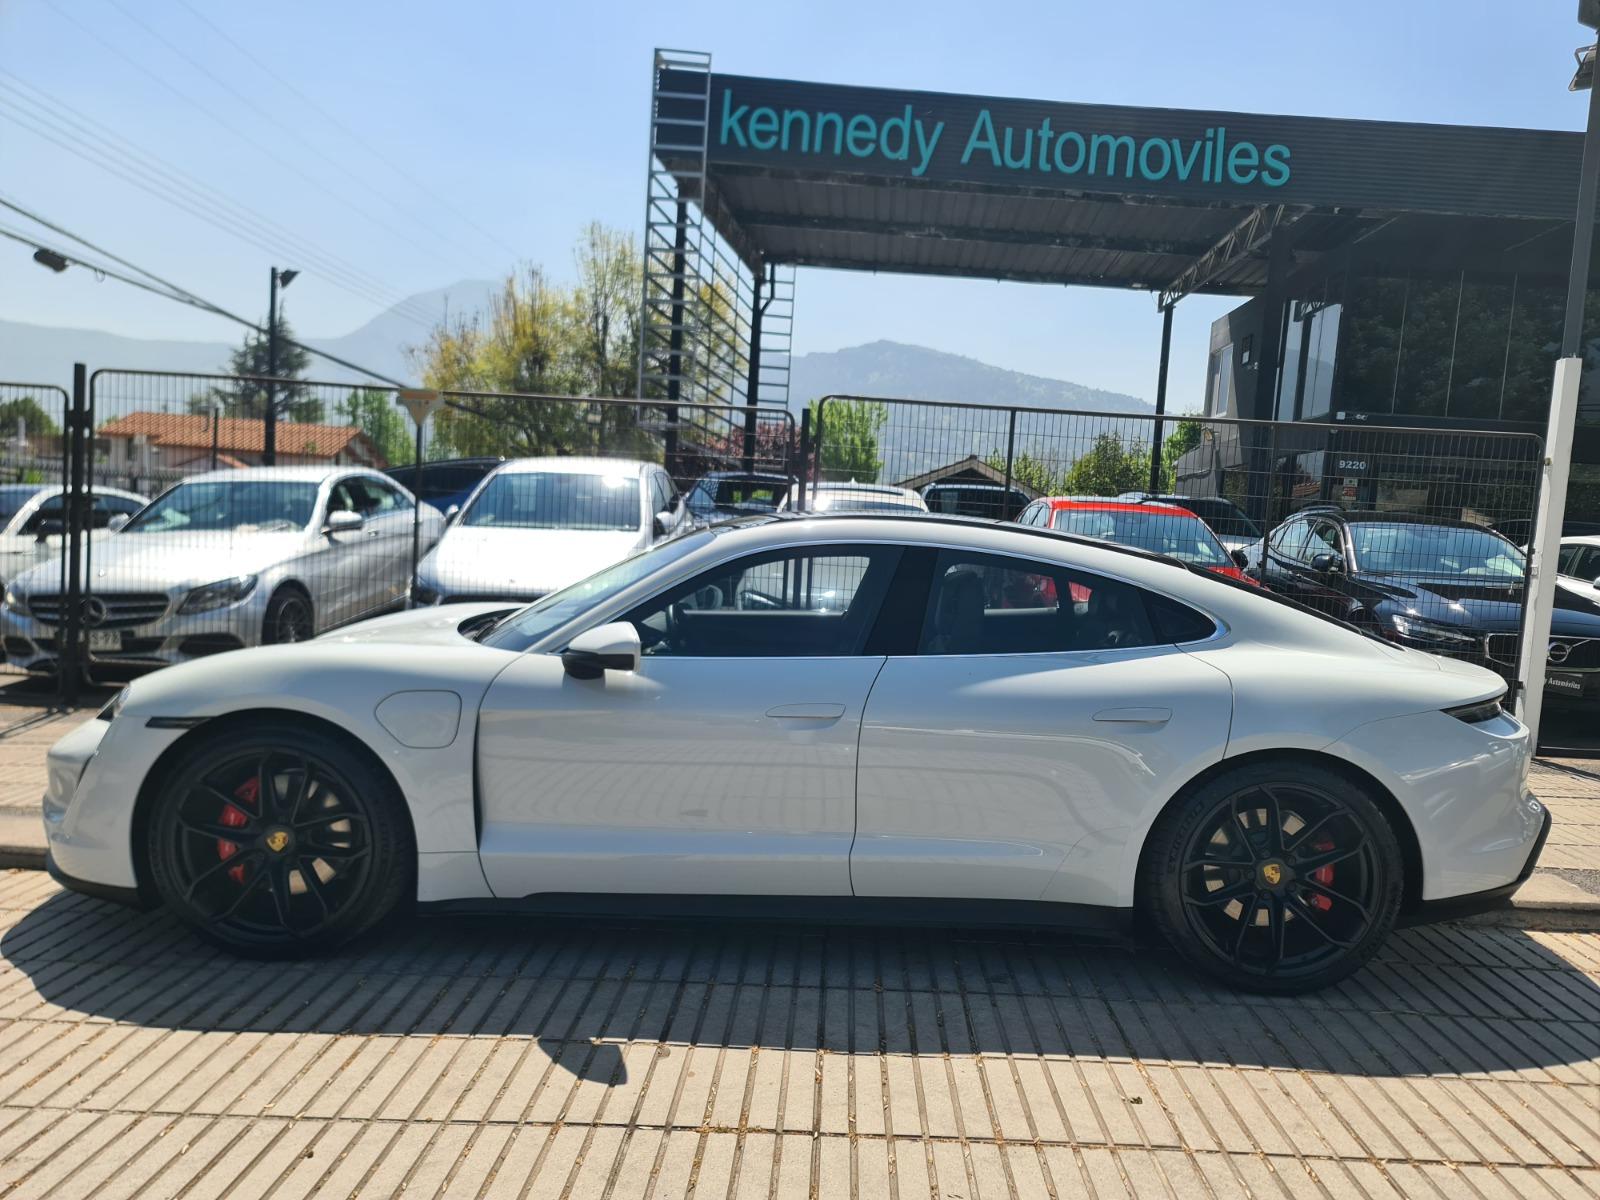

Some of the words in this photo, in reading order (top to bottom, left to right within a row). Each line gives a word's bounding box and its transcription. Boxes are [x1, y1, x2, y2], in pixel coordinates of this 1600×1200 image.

[720, 89, 945, 176] kennedy
[961, 110, 1291, 187] Automoviles
[1339, 460, 1366, 470] 9220
